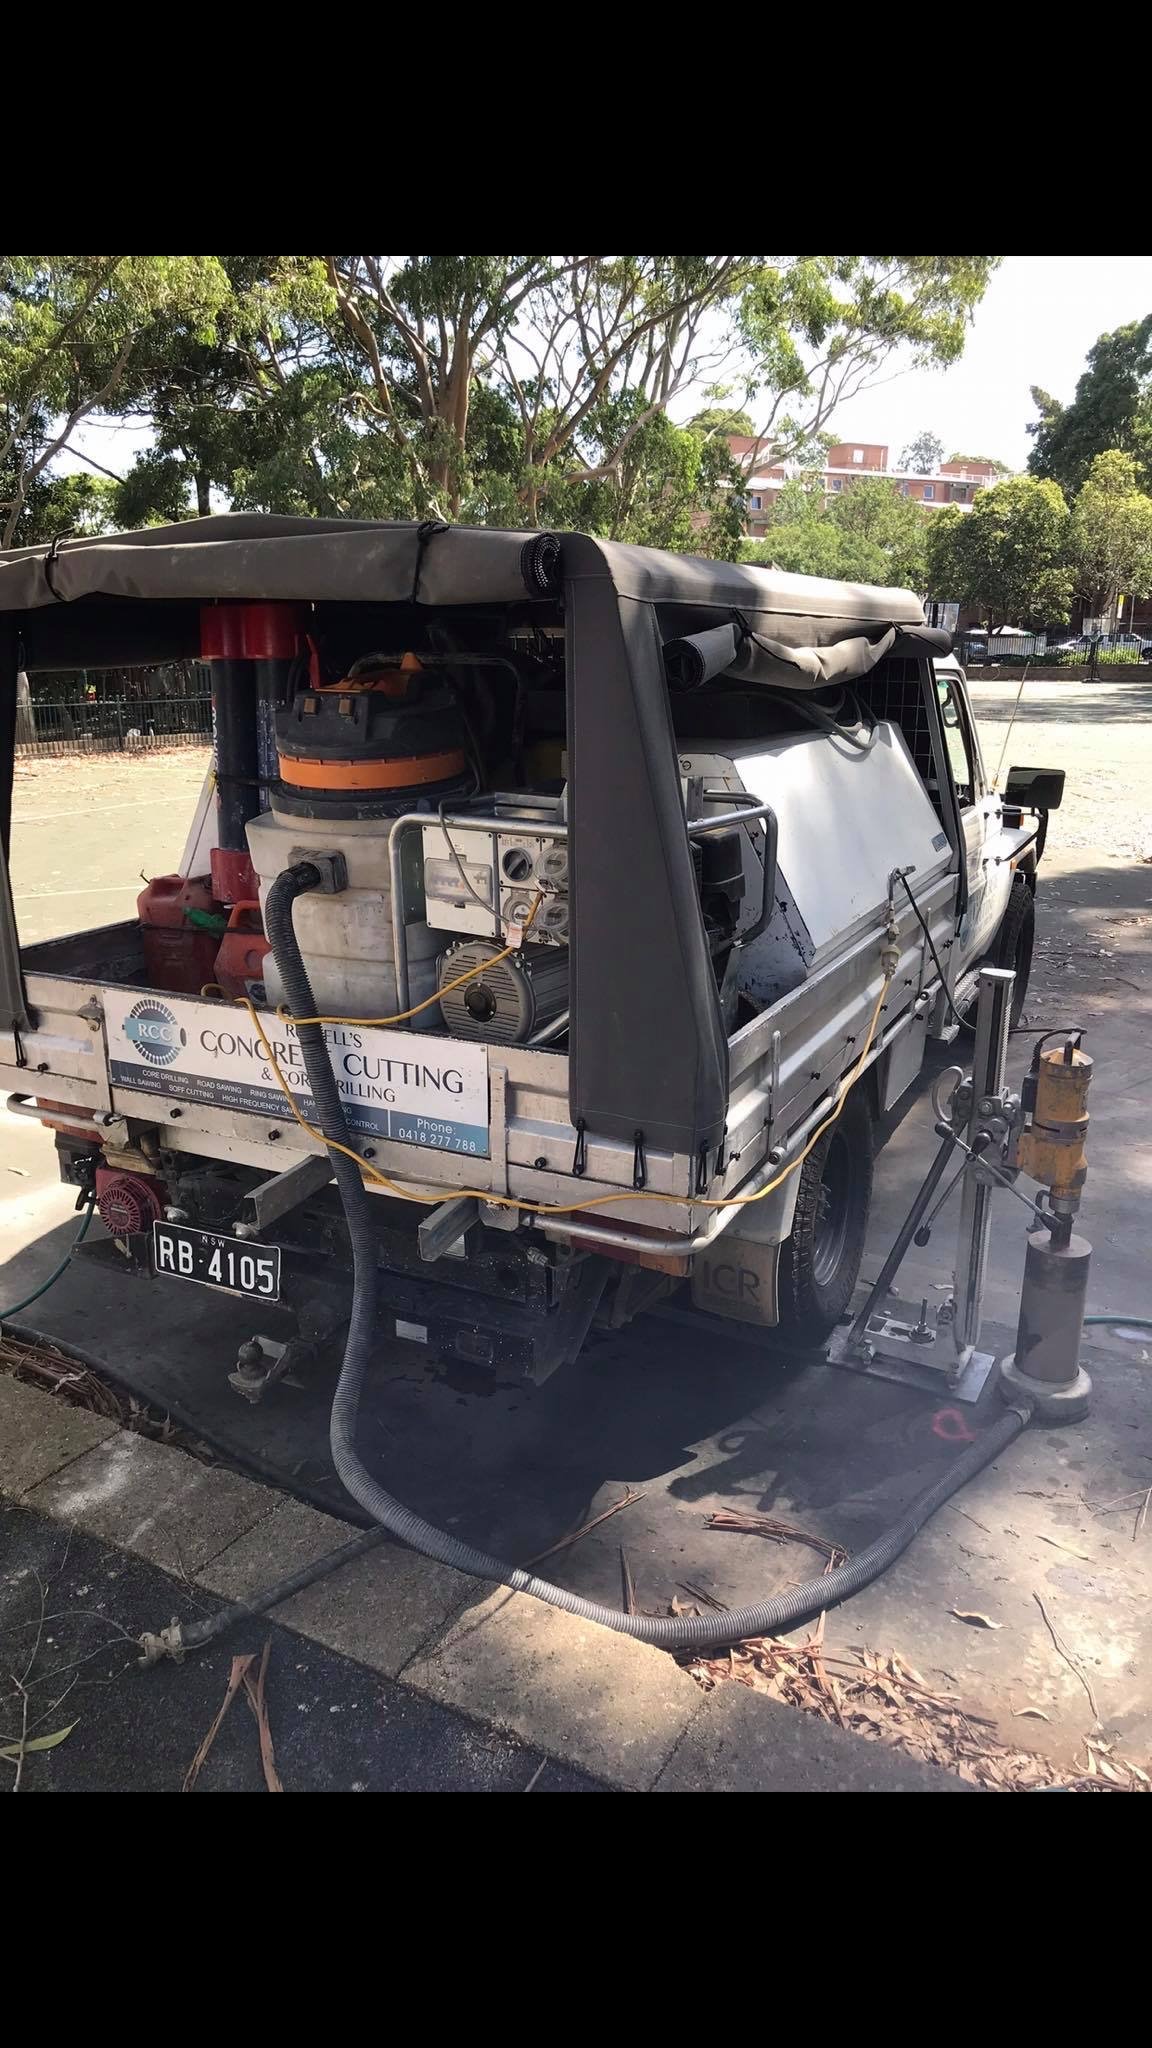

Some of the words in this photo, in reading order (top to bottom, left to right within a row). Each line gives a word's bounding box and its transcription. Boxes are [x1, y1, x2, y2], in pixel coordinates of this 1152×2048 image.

[138, 1023, 173, 1042] RCC
[200, 1030, 331, 1067] CONCRE
[343, 1053, 464, 1094] CUTTING
[142, 1069, 160, 1079] CORE
[161, 1073, 189, 1084] DRILLING
[197, 1079, 216, 1089] ROAD
[216, 1083, 243, 1094] SAWING
[250, 1089, 267, 1099] RING
[261, 1067, 273, 1081] &
[280, 1069, 312, 1087] COR
[336, 1079, 396, 1103] RILLING
[120, 1075, 137, 1085] WALL
[137, 1078, 162, 1089] SAWING
[186, 1087, 215, 1099] CUTTING
[222, 1094, 239, 1104] HIGH
[239, 1097, 280, 1111] FREQUENCY
[345, 1118, 380, 1131] CONTROL
[398, 1129, 427, 1143] 0418
[430, 1133, 451, 1147] 277
[455, 1138, 476, 1152] 788
[417, 1118, 457, 1135] Phone:
[201, 1235, 226, 1248] NSW
[703, 1261, 761, 1302] ICR
